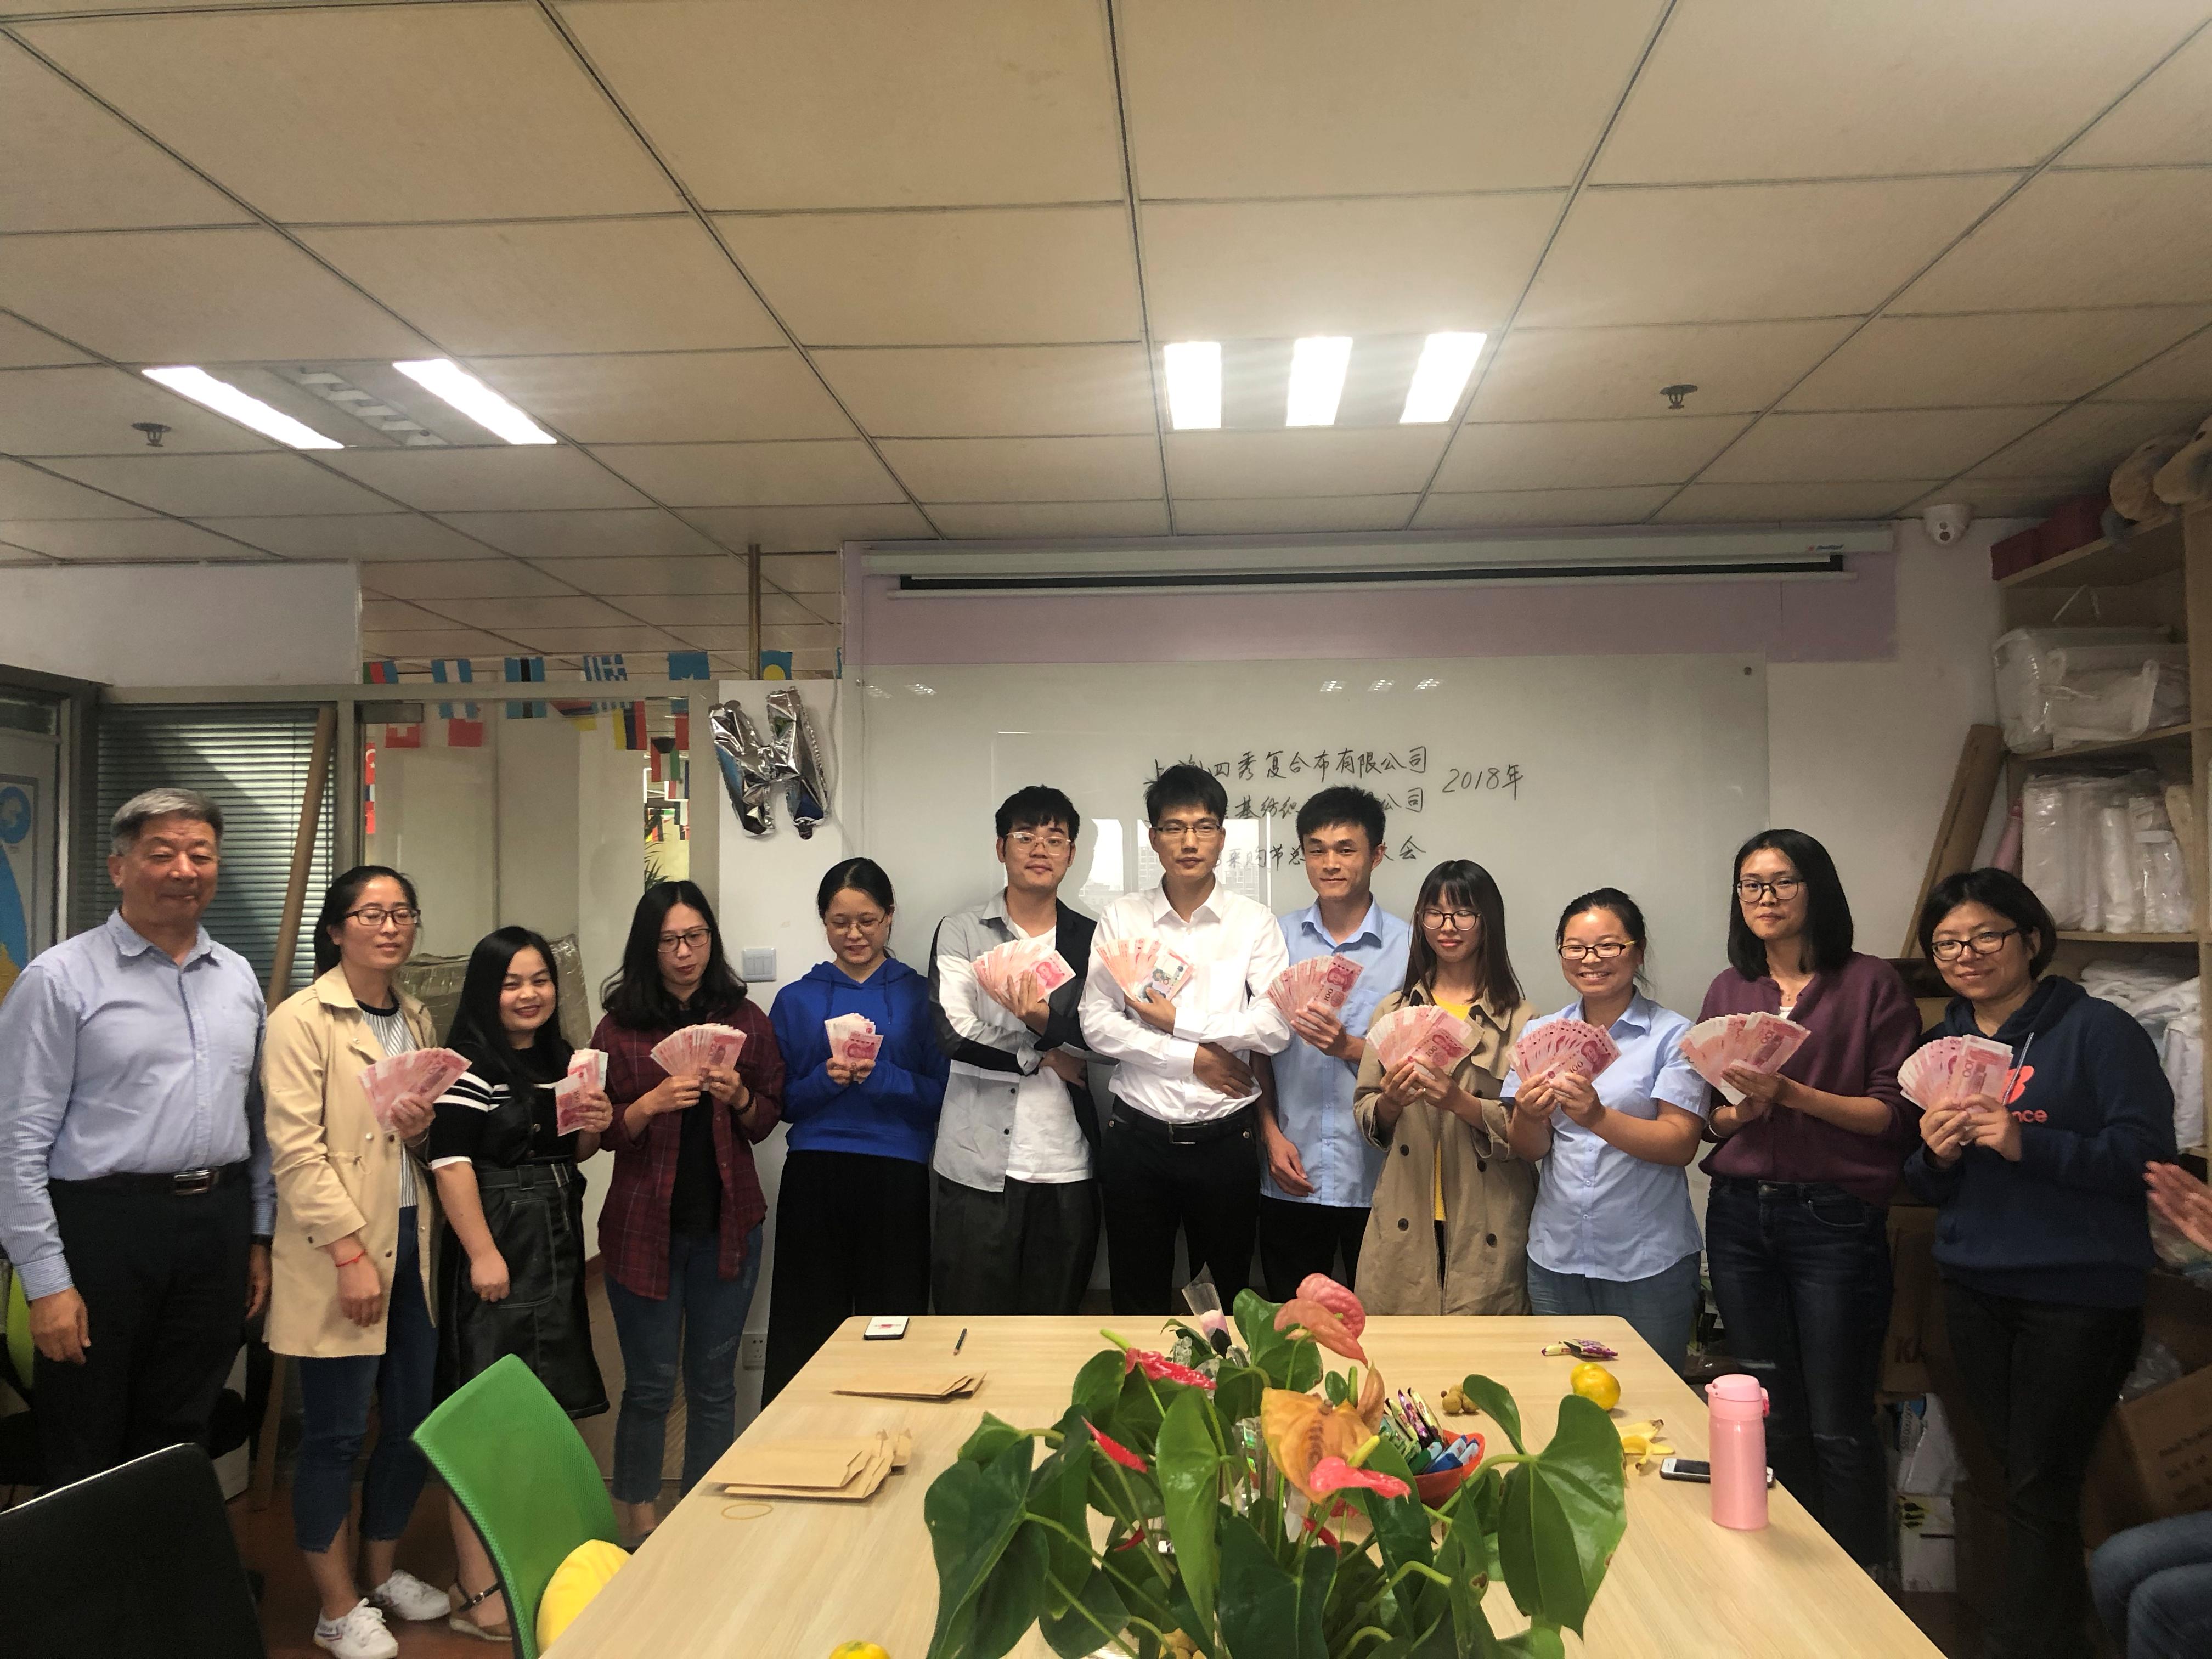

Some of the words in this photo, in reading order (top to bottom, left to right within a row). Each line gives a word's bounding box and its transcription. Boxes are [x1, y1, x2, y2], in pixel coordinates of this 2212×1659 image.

[1442, 764, 1524, 801] 2018年
[1323, 988, 1334, 1001] 100
[1425, 1046, 1438, 1057] 100
[1569, 1061, 1583, 1074] 100
[2011, 1110, 2048, 1123] nce
